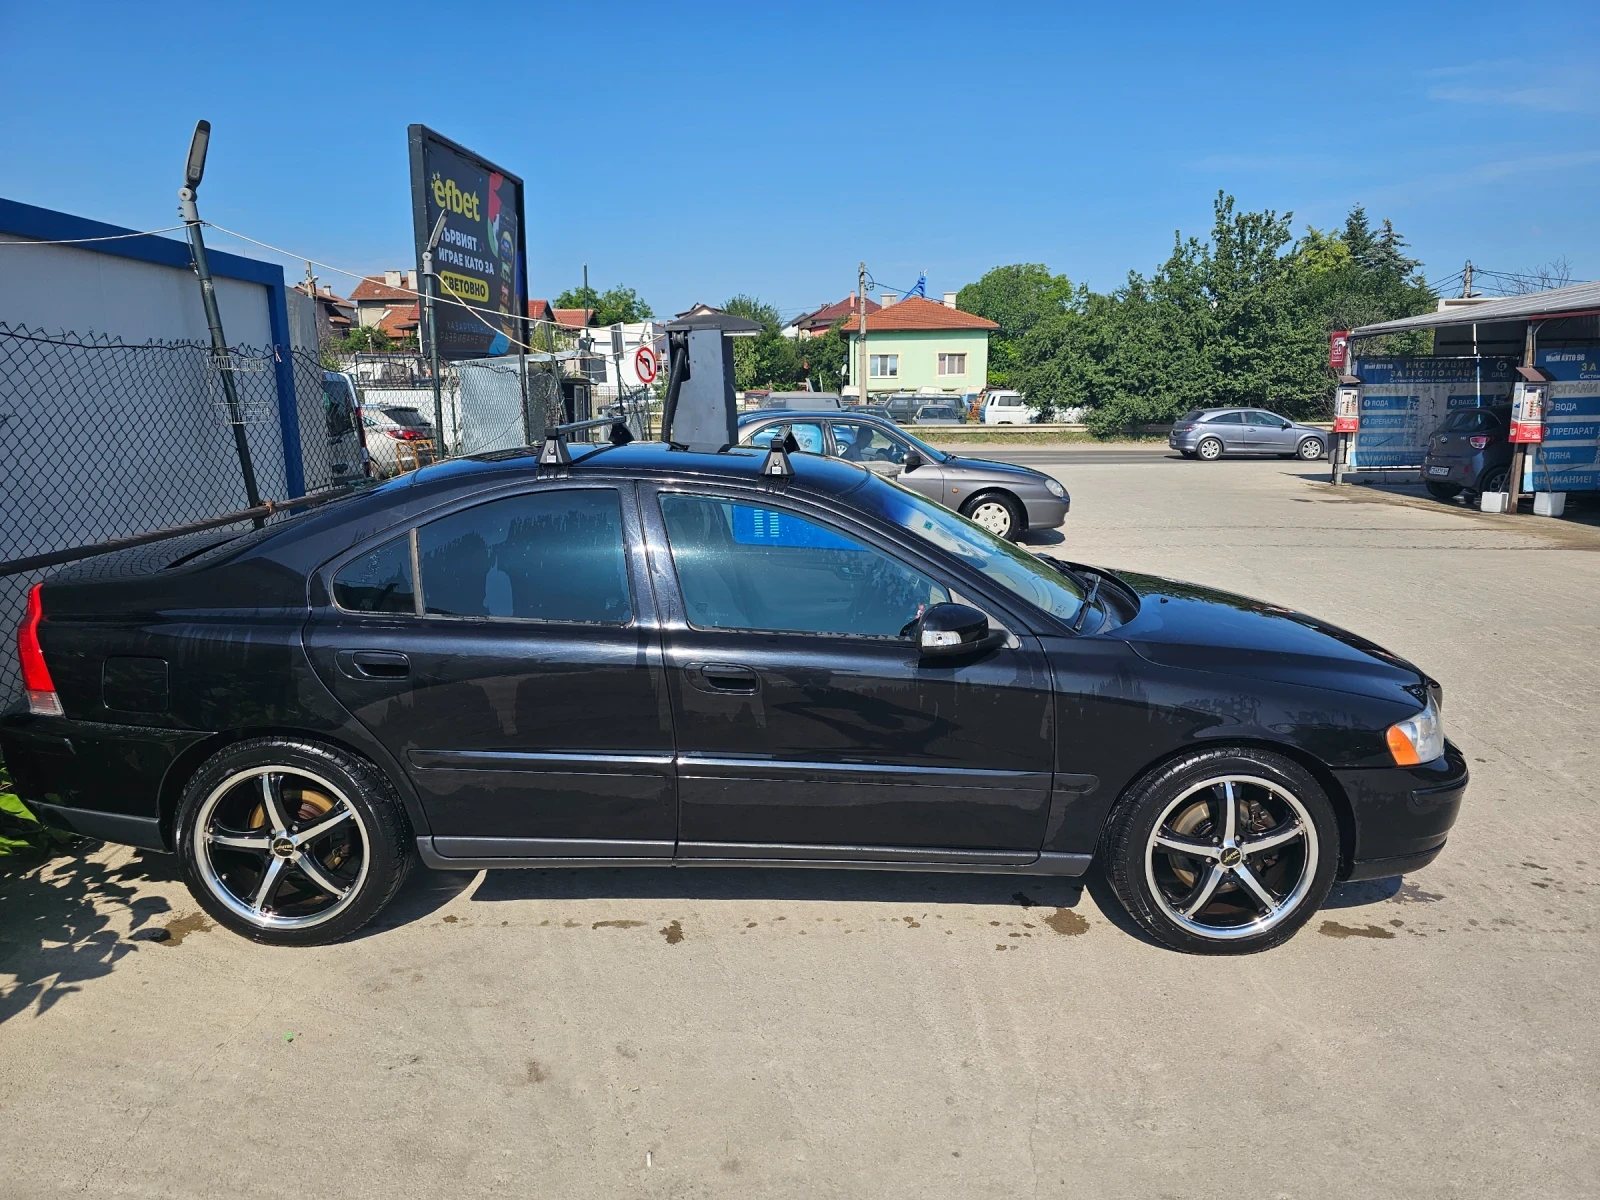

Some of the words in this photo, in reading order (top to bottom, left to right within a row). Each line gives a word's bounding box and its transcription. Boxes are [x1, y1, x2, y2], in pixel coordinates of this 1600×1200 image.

[434, 178, 480, 222] efbet
[438, 247, 463, 267] ИГРАЕ
[464, 256, 484, 272] КАТО
[484, 262, 495, 276] ЗА
[443, 275, 486, 298] СВЕТОВНО
[1405, 361, 1471, 369] ИНСТРУКЦИЯ
[1581, 362, 1597, 371] ЗА
[1550, 383, 1599, 394] РОГРАМИ
[1554, 402, 1577, 411] ВОДА
[1552, 427, 1594, 436] ПРЕПАРАТ
[1548, 451, 1571, 460] ПЯНА
